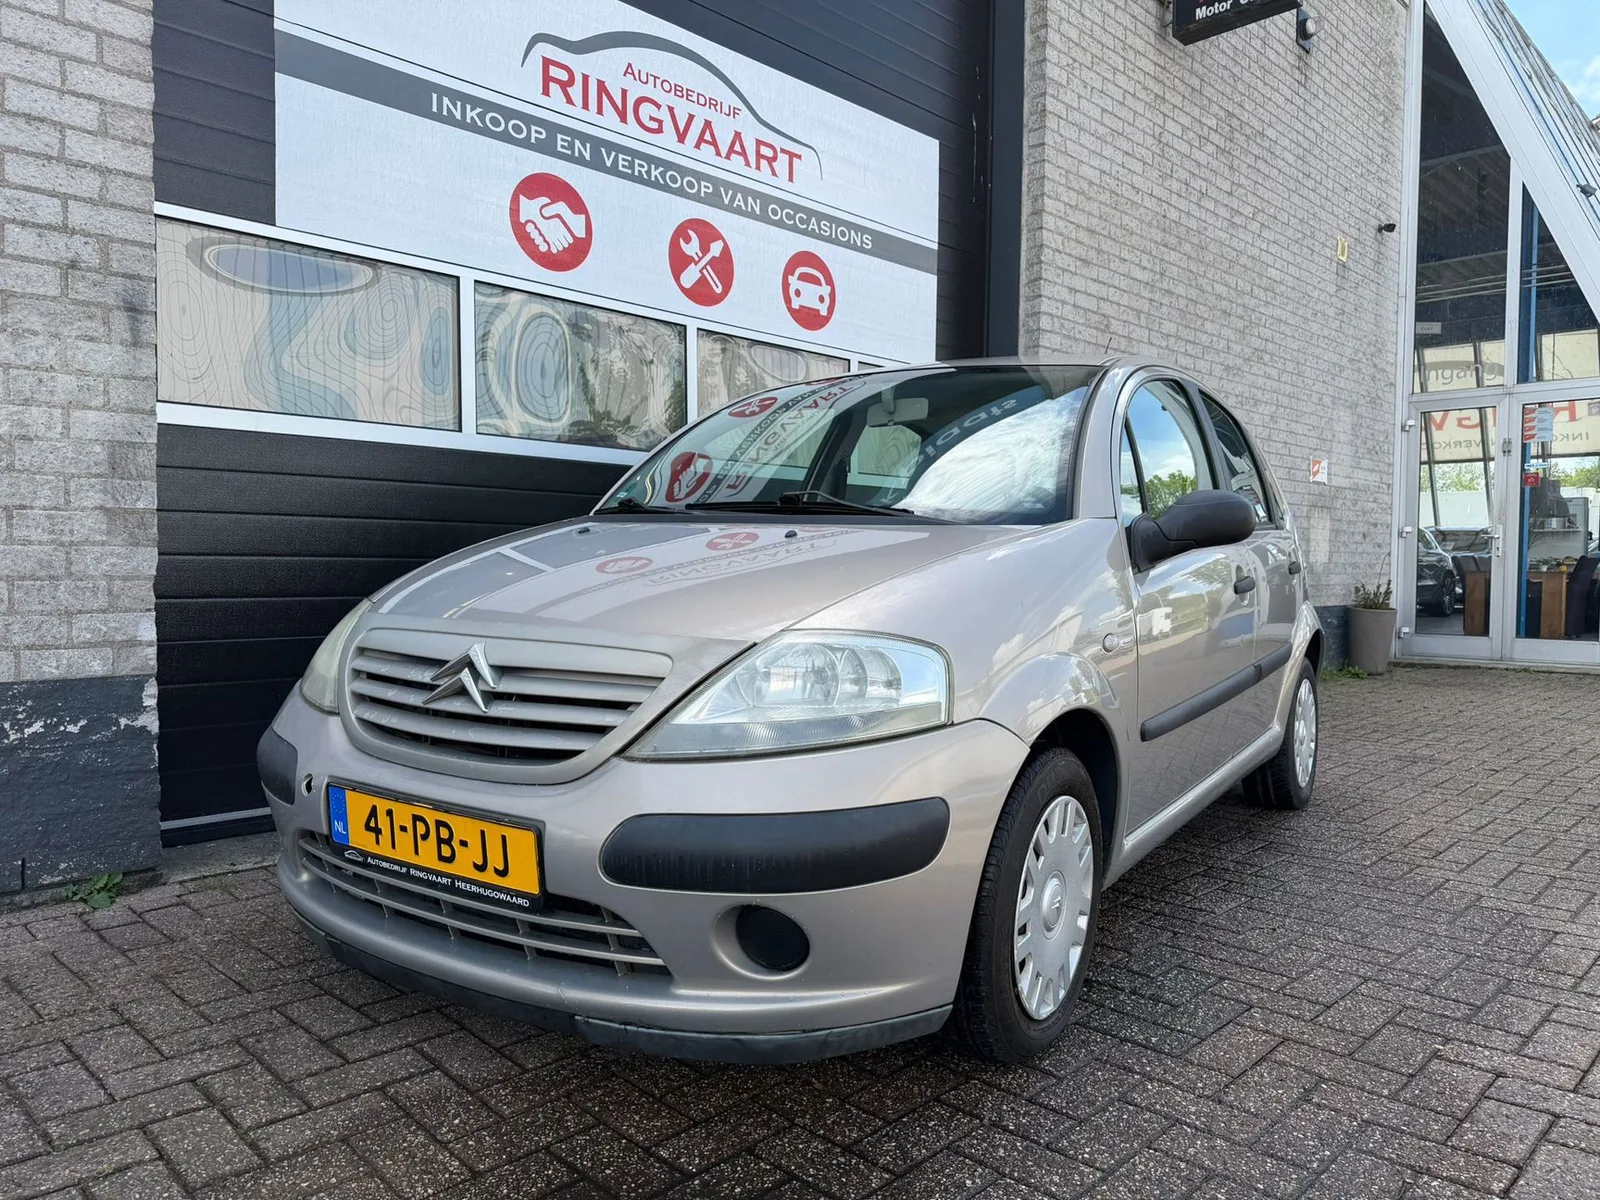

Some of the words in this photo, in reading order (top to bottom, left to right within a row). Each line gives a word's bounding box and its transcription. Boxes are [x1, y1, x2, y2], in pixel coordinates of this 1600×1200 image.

[1195, 0, 1233, 20] Motor
[540, 55, 802, 184] RINGVAART
[623, 62, 742, 120] AUTOBEDRIJF
[431, 93, 546, 144] INKOOP
[556, 136, 592, 160] EN
[601, 148, 714, 198] VERKOOP
[720, 187, 760, 215] VAN
[767, 204, 873, 249] OCCASIONS
[334, 819, 347, 834] NL
[364, 804, 510, 878] 41-PB-JJ
